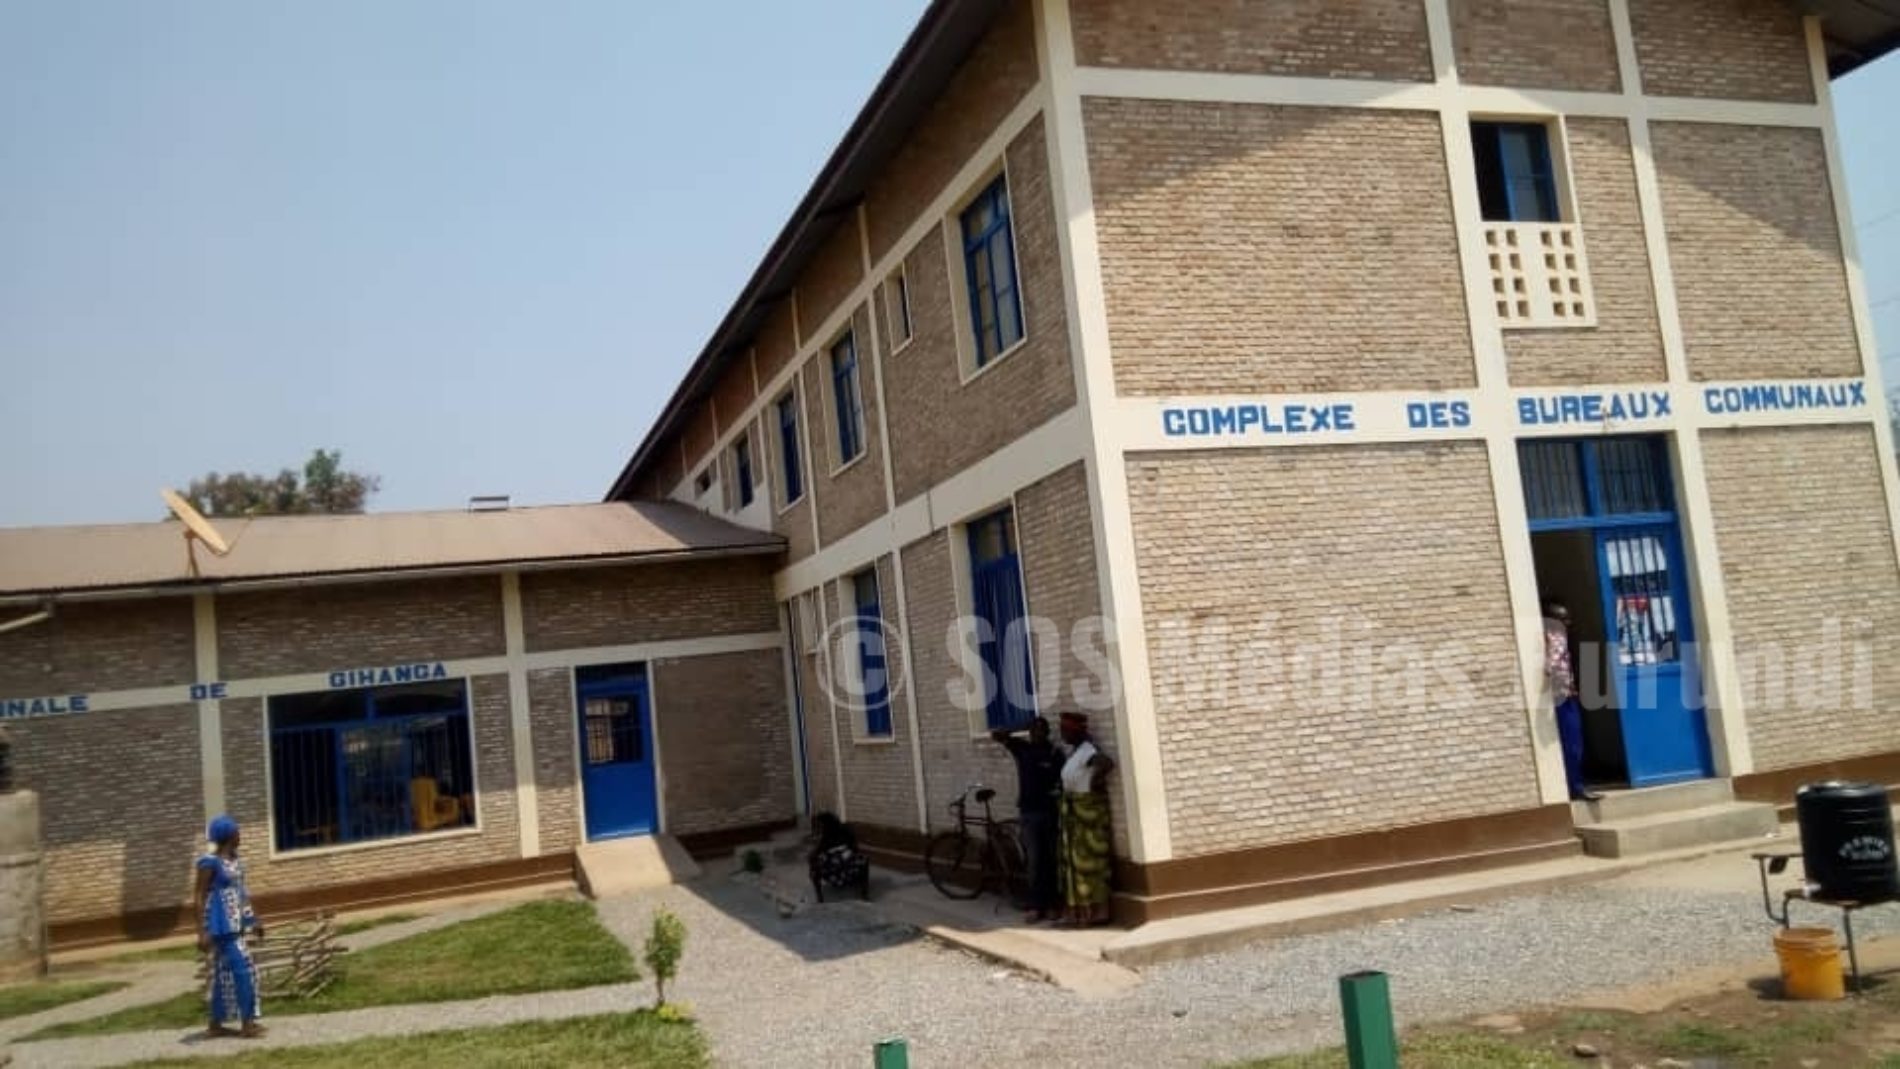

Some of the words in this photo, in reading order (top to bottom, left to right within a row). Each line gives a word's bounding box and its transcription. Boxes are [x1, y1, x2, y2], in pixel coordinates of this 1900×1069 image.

[1163, 404, 1355, 436] COMPLEXE
[1406, 401, 1471, 428] DES
[1518, 391, 1672, 424] BUREAUX
[1704, 381, 1866, 414] COMMUNAUX
[0, 695, 89, 718] NALE
[189, 682, 228, 701] DE
